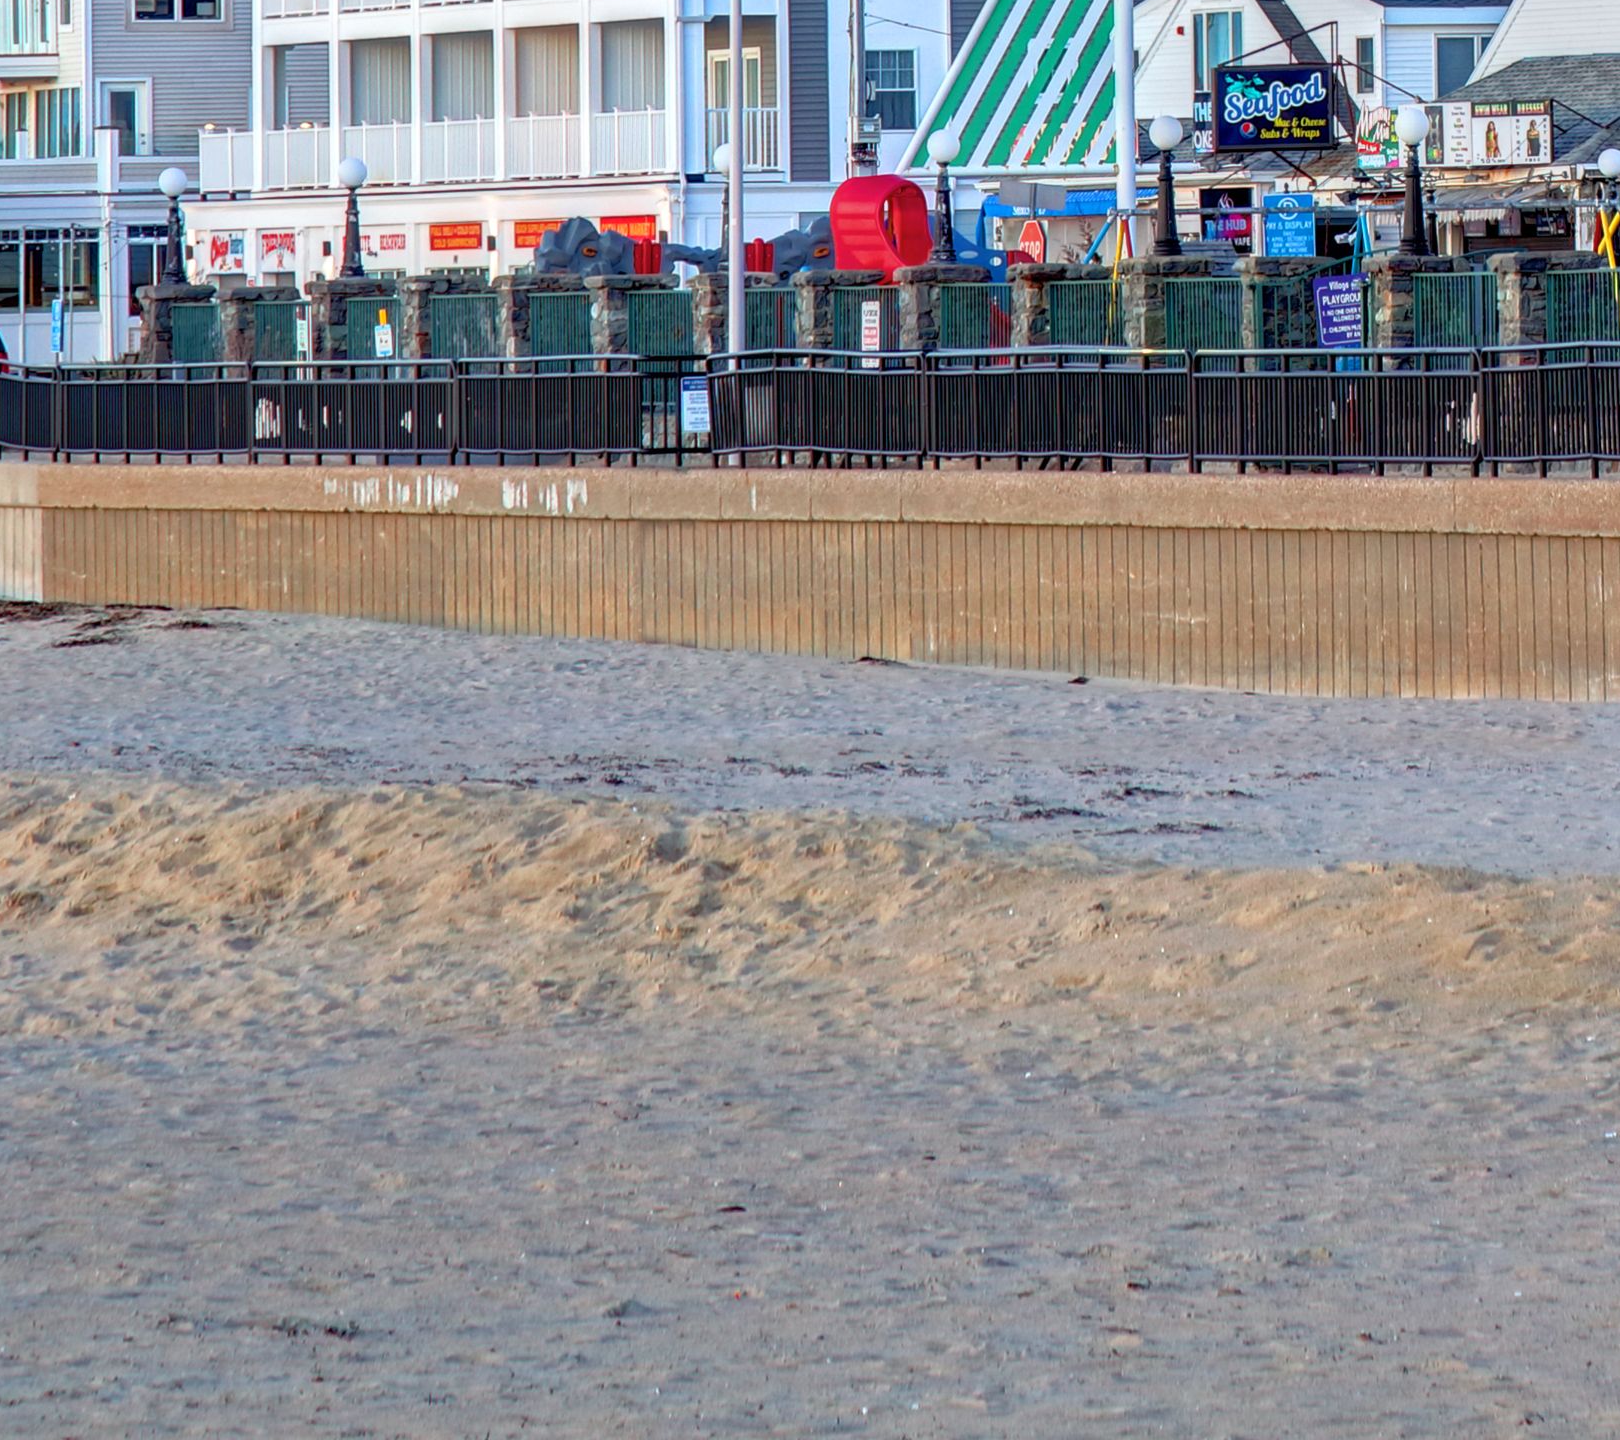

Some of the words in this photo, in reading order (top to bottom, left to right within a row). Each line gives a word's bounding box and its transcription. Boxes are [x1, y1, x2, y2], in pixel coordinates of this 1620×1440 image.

[1224, 71, 1326, 124] Seafood
[1194, 101, 1212, 123] THE
[1273, 116, 1291, 128] Mac
[1291, 117, 1299, 127] &
[1300, 117, 1326, 127] Cheese
[1260, 128, 1280, 139] Subs
[1282, 127, 1289, 138] &
[1291, 127, 1320, 140] Wraps
[1225, 218, 1247, 231] HUB
[1284, 220, 1312, 230] DISPLAY
